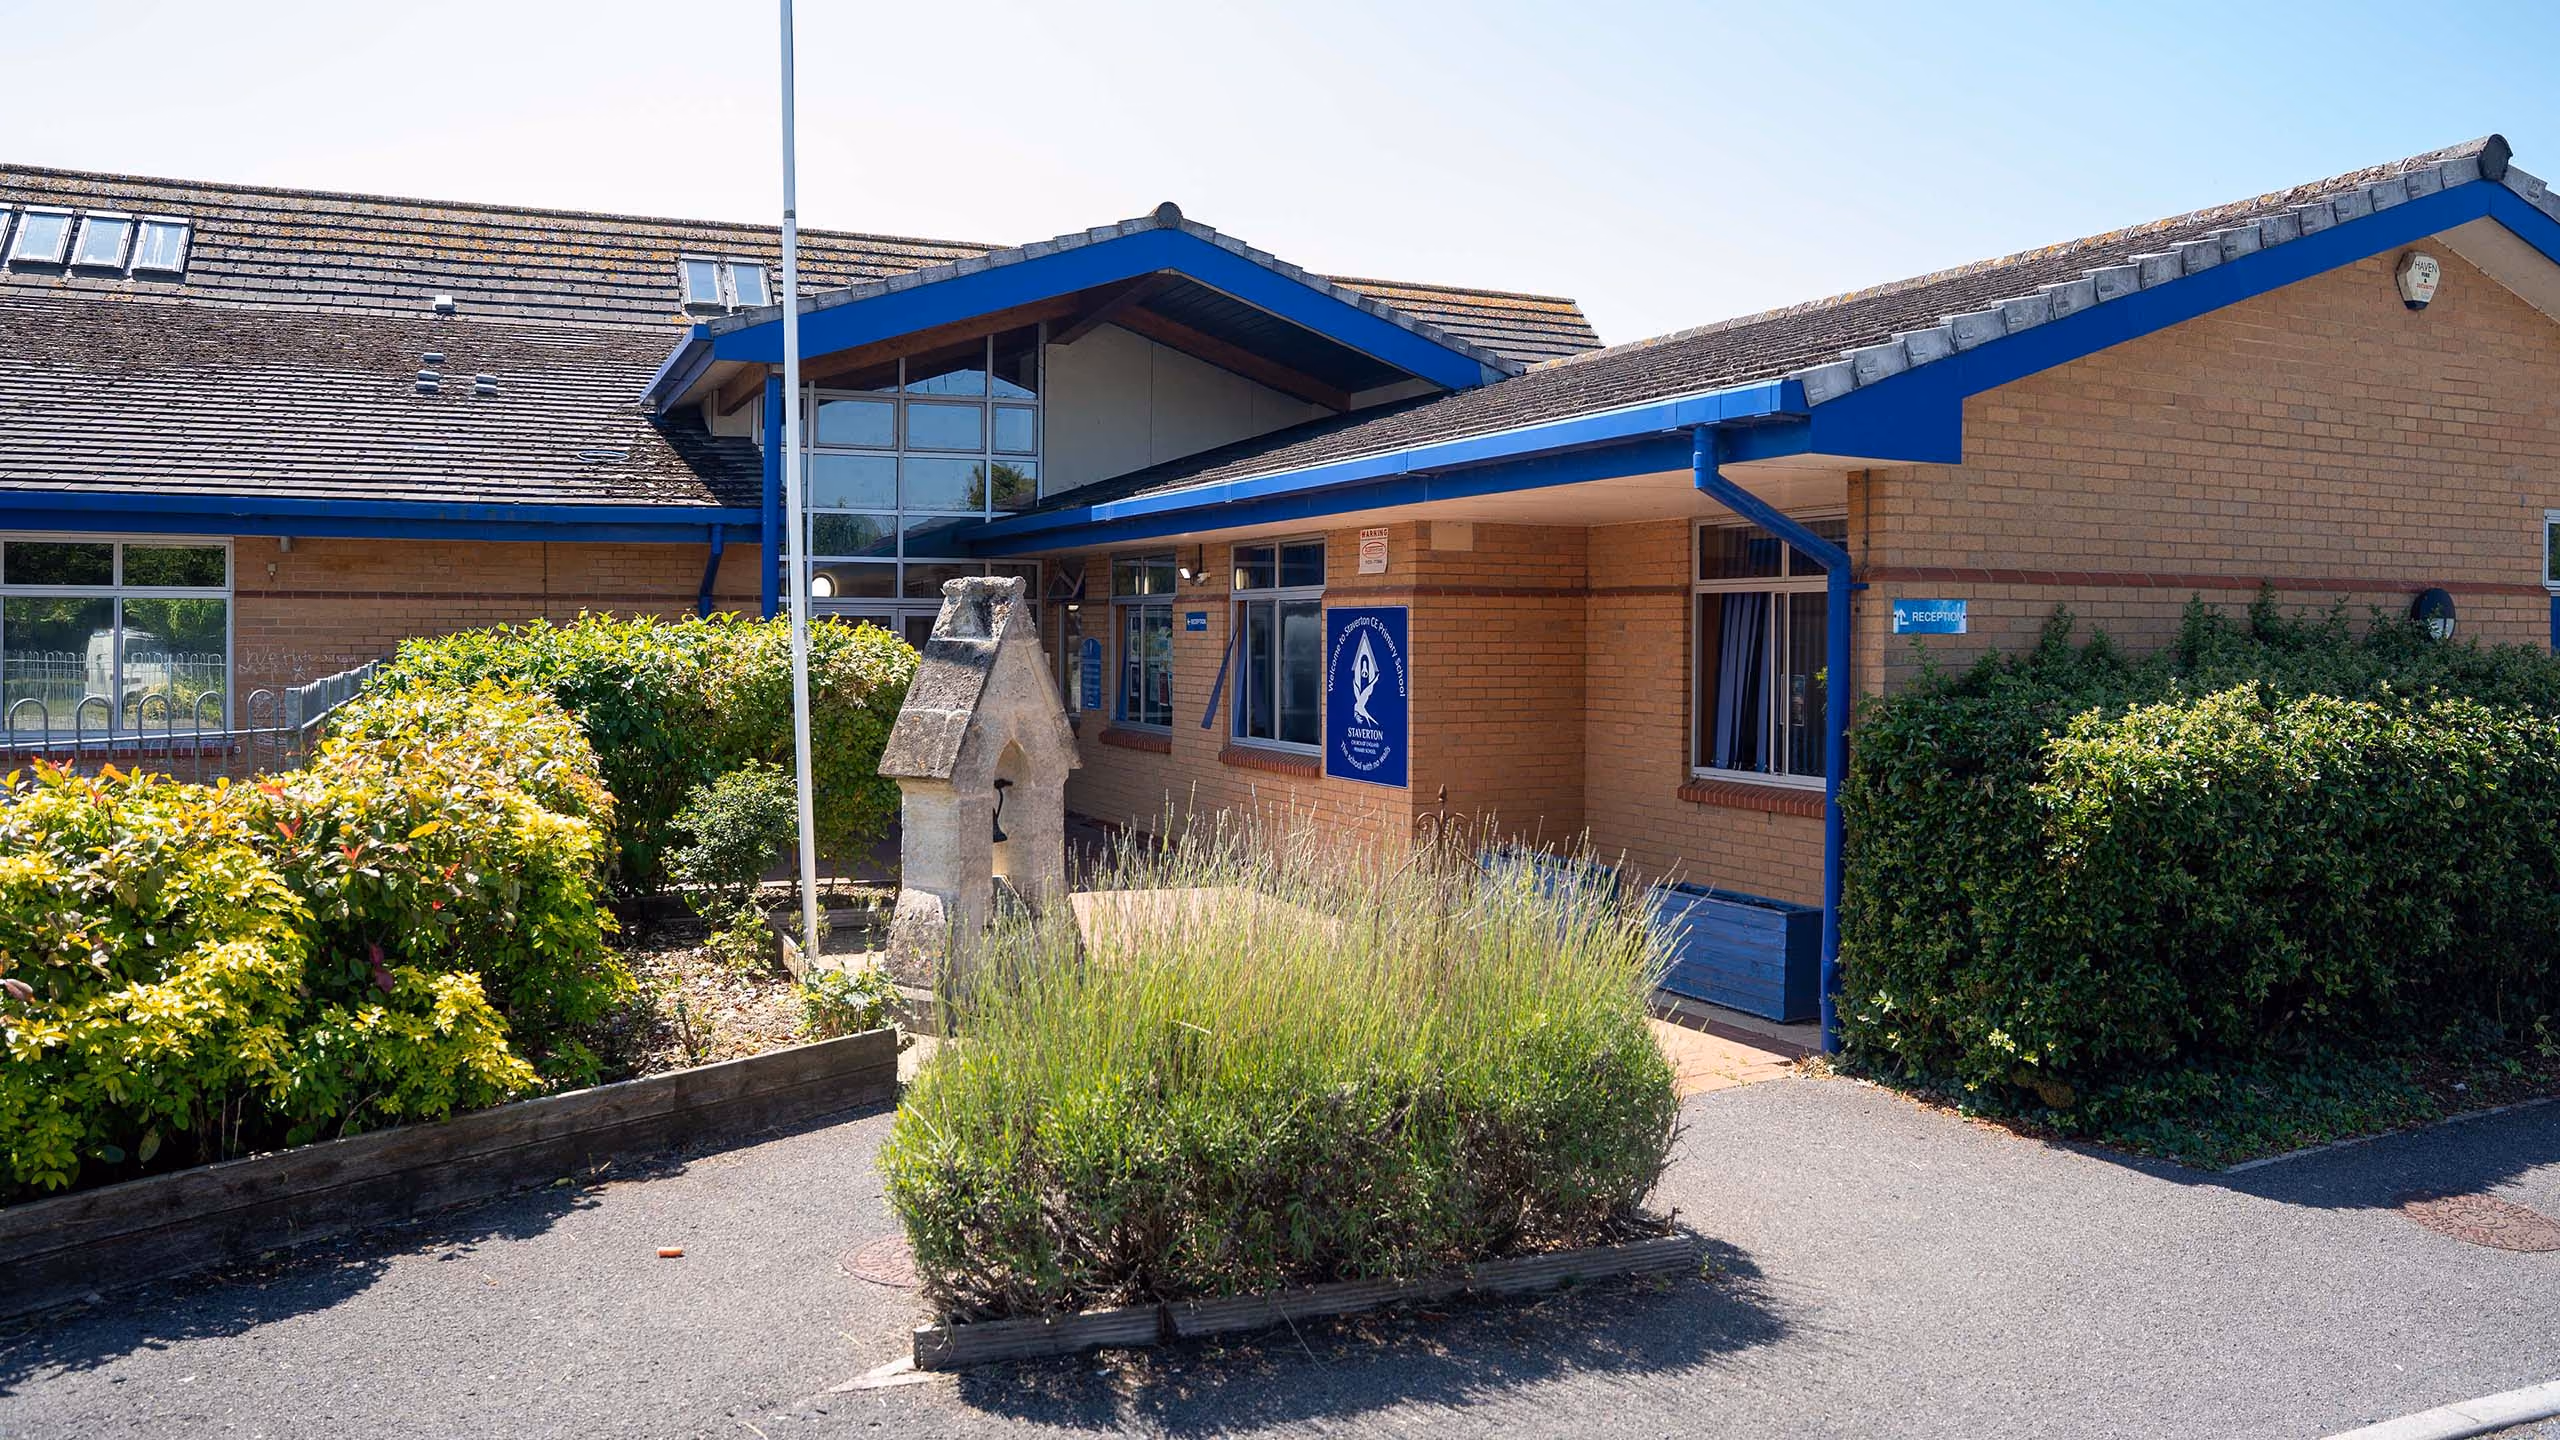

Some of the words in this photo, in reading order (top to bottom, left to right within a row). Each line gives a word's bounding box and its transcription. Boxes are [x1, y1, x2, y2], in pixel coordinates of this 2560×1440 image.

[2414, 261, 2438, 273] HAVEN
[1361, 528, 1388, 538] WARNING
[1912, 611, 1963, 622] RECEPTION
[1328, 644, 1341, 692] Welcome
[1339, 634, 1346, 645] to
[1344, 616, 1371, 636] Staverton
[1370, 616, 1379, 629] CE
[1378, 622, 1398, 658] Primary
[1395, 657, 1405, 697] School
[1347, 727, 1383, 740] STAVERTON
[1347, 754, 1362, 770] school
[1362, 760, 1373, 771] with
